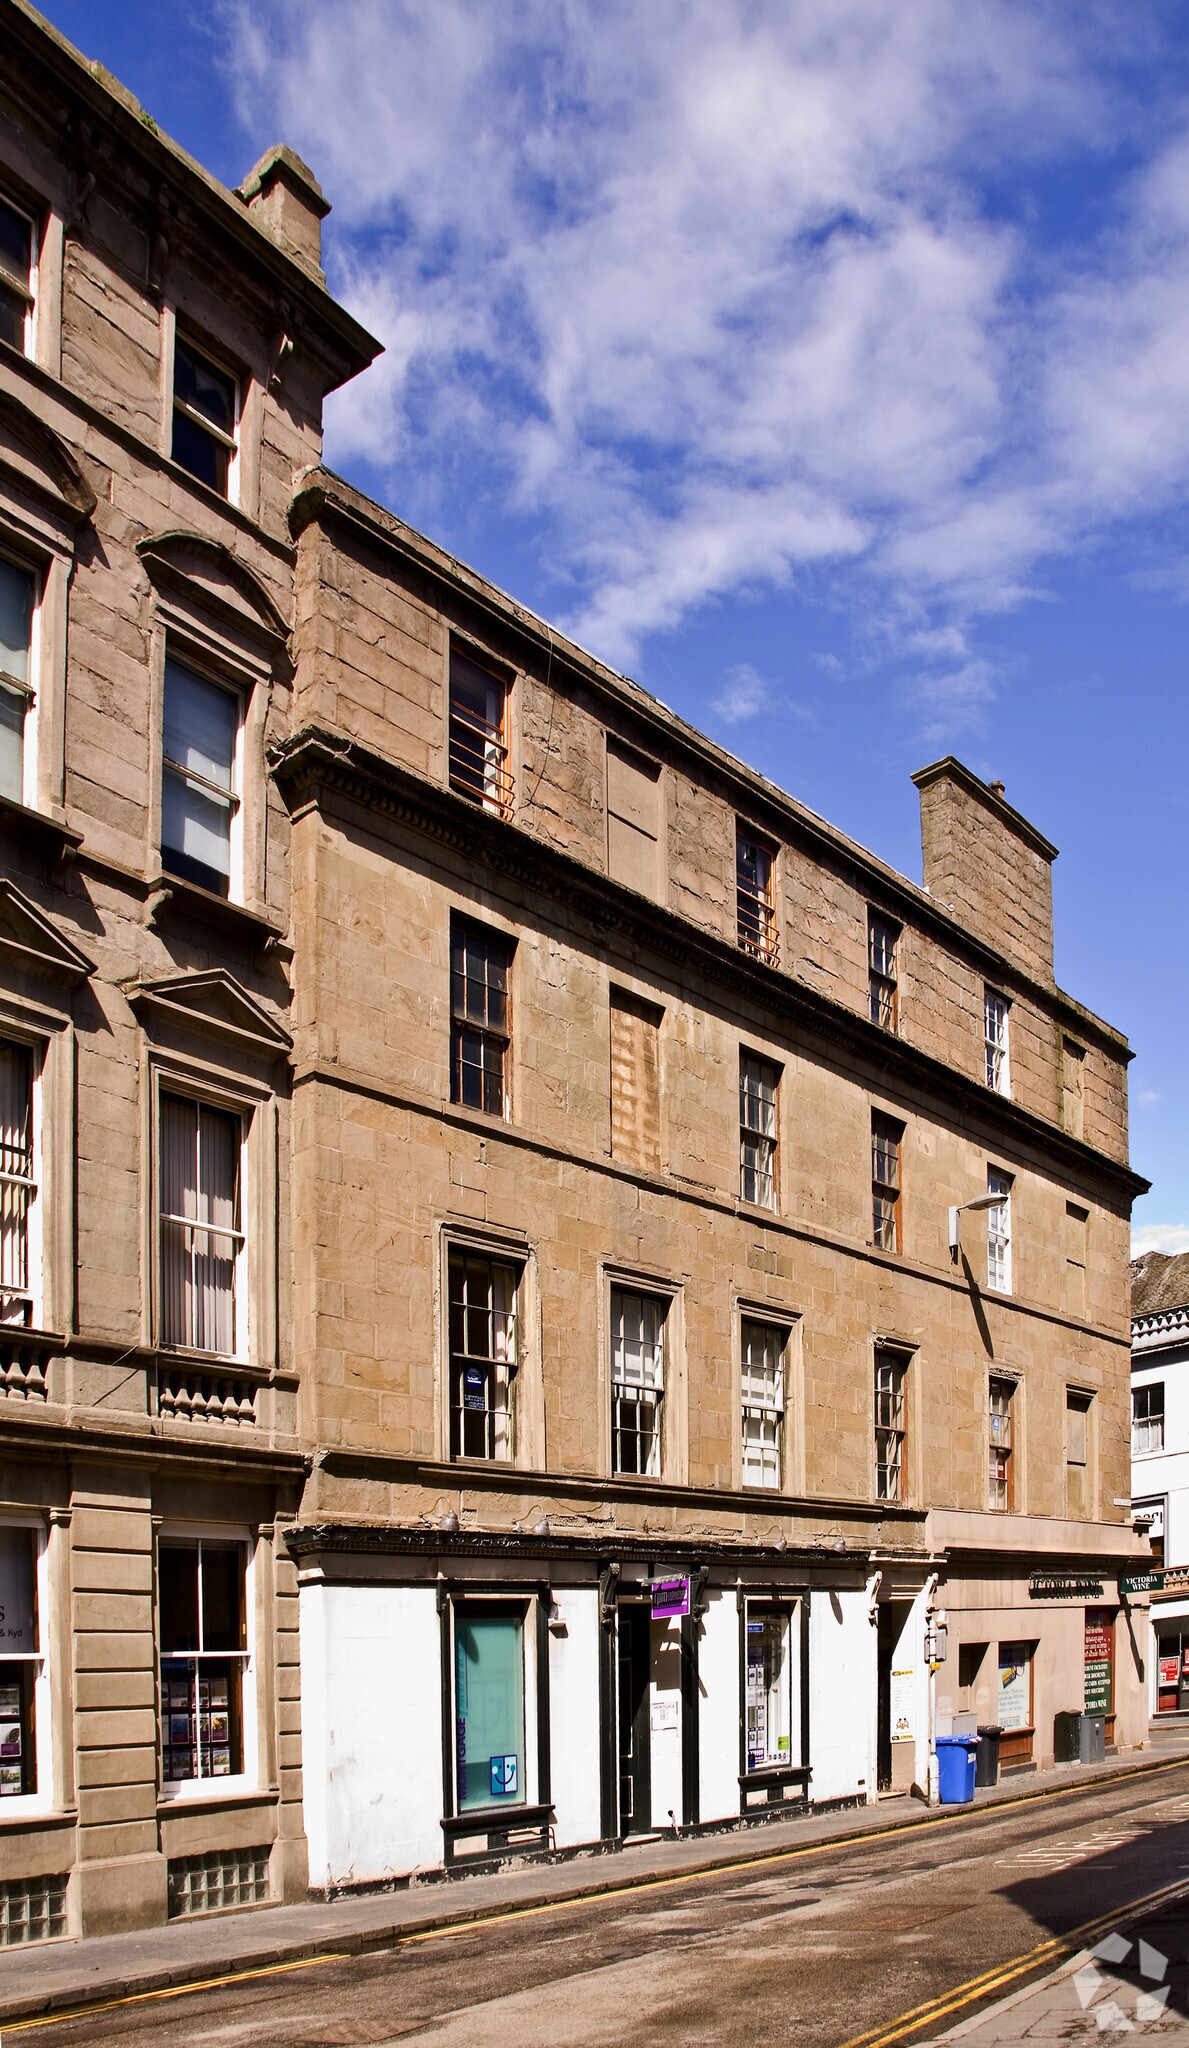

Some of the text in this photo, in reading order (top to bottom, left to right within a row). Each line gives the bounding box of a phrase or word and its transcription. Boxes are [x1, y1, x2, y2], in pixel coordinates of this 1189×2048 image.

[1126, 1575, 1158, 1585] VICTORIA
[1132, 1583, 1151, 1591] WINE
[8, 1628, 23, 1639] Kyd
[457, 1717, 467, 1800] MORTGAGE
